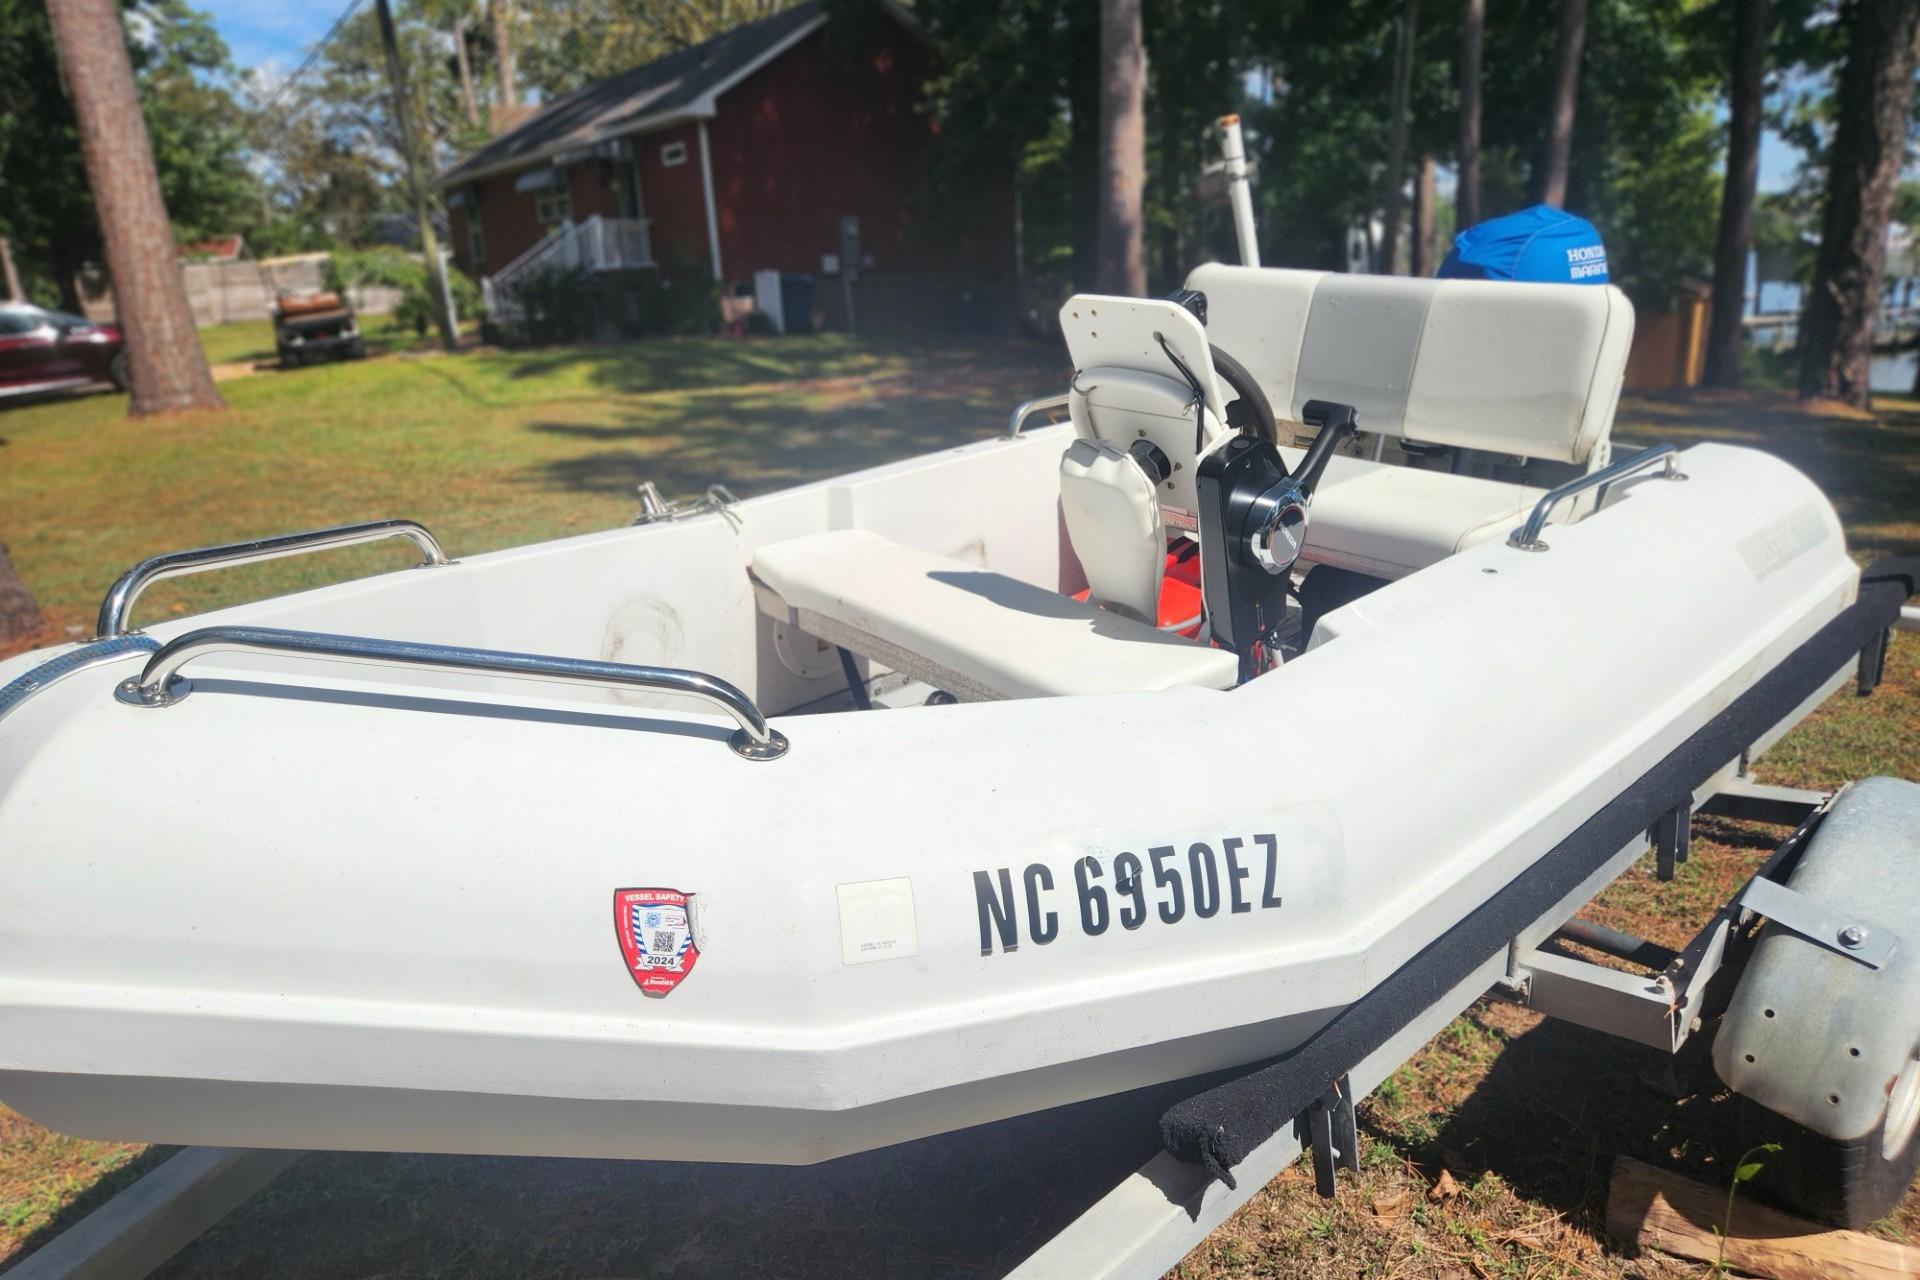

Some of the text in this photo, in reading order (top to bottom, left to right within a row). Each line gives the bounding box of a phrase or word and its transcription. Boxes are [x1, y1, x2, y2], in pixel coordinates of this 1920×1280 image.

[1570, 261, 1608, 279] MARIN
[625, 893, 654, 902] VESSEL
[655, 893, 685, 902] SAFETY
[973, 833, 1282, 957] NC 6950EZ
[646, 955, 675, 966] 2024
